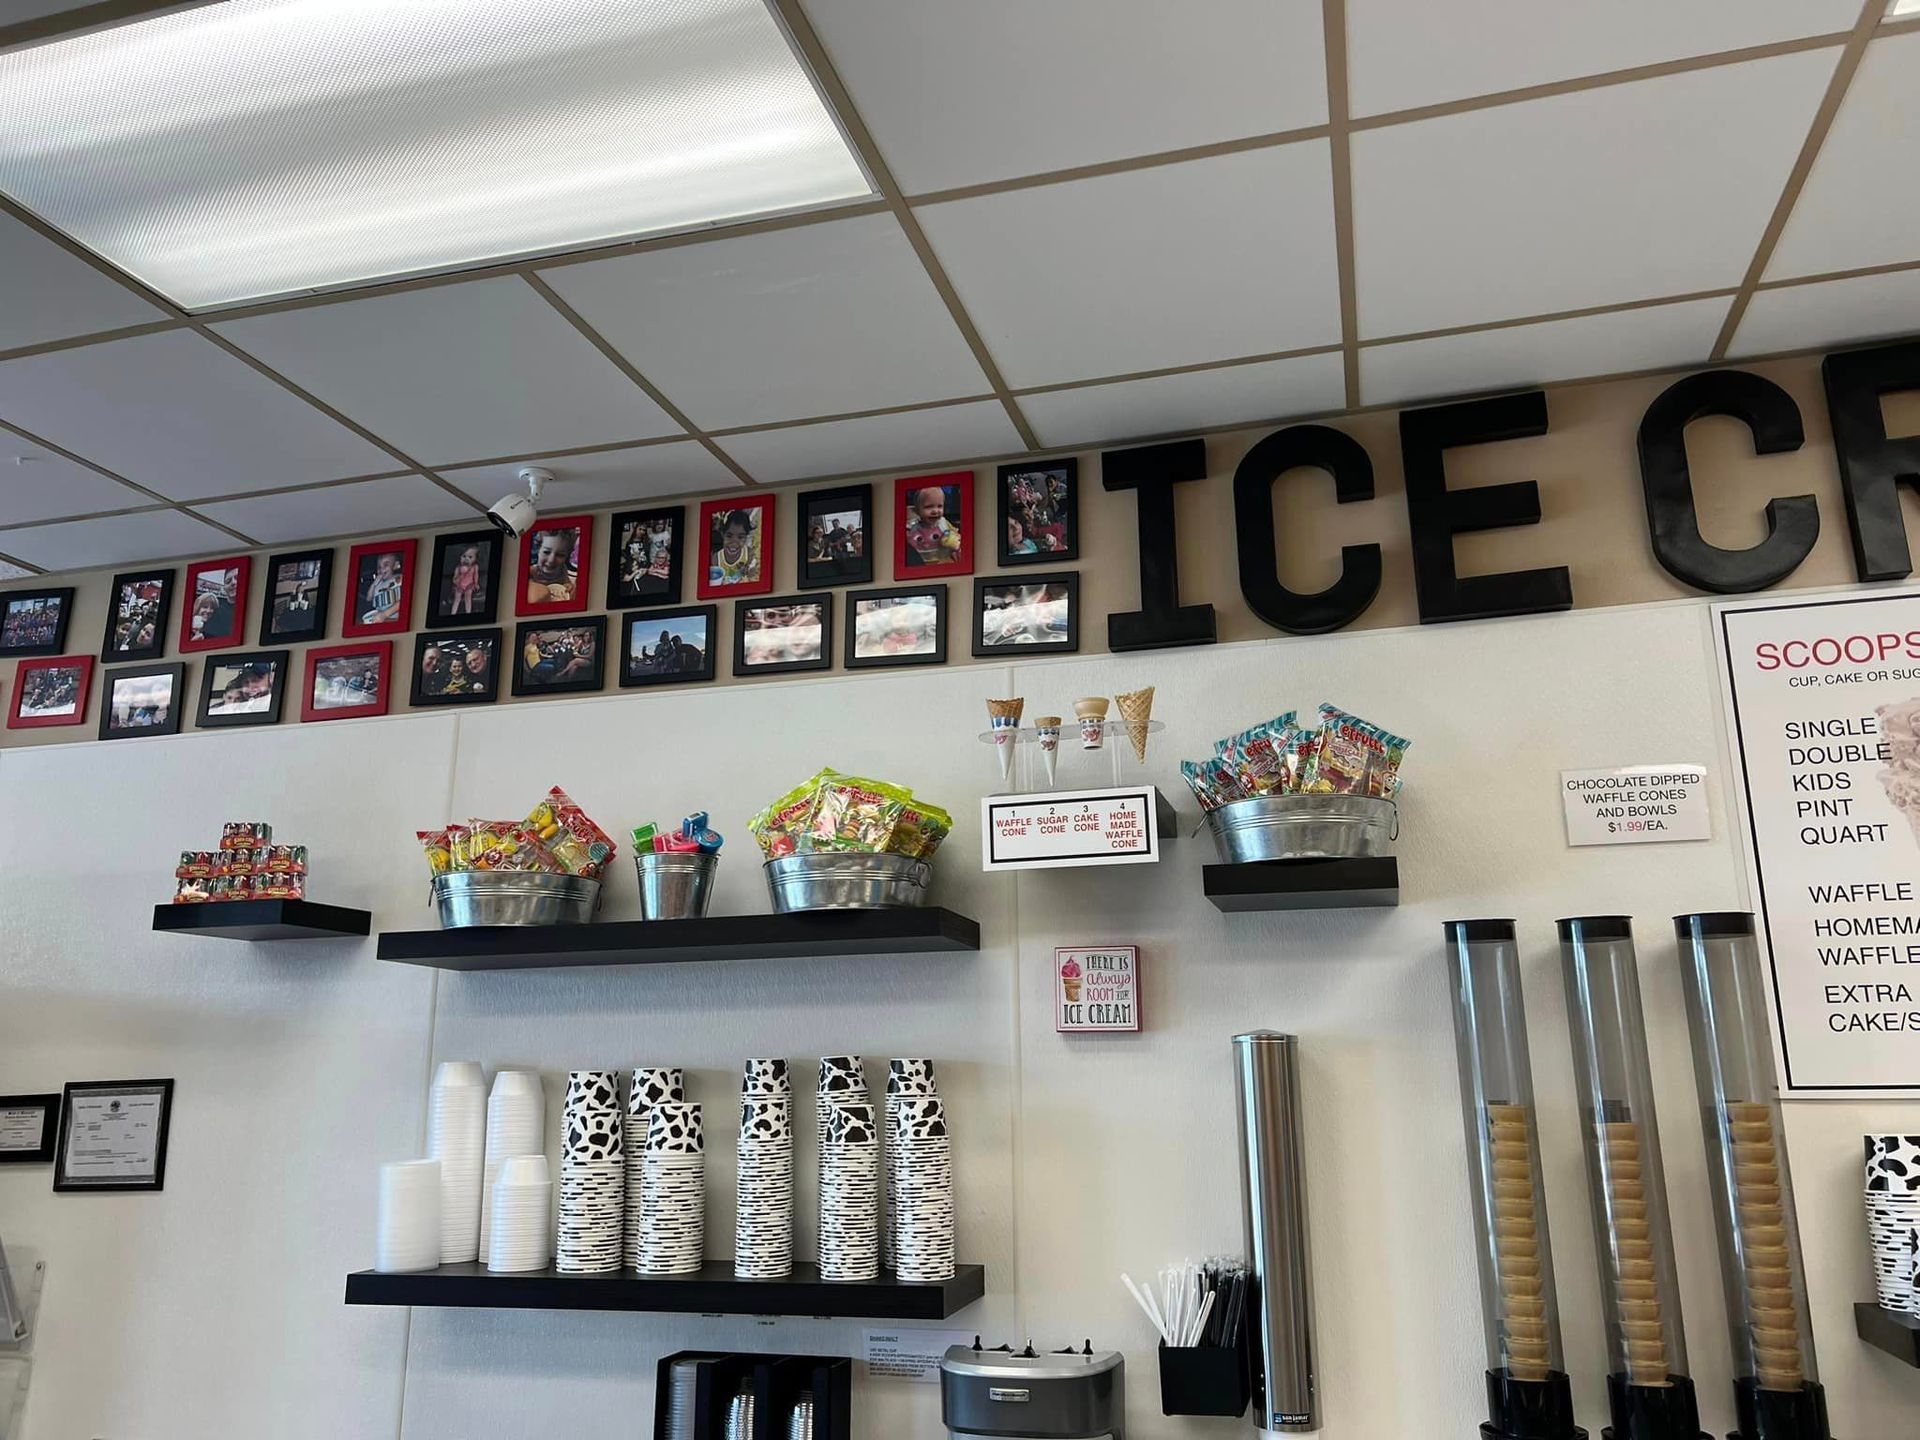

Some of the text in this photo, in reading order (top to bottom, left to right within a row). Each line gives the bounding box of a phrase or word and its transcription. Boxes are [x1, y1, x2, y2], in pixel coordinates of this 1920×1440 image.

[1101, 391, 1572, 652] ICE
[1789, 676, 1821, 688] CUP,
[1824, 672, 1863, 685] CAKE
[1867, 670, 1889, 682] OR
[1785, 717, 1877, 740] SINGLE
[1789, 743, 1893, 766] DOUBLE
[1566, 773, 1700, 791] CHOCOLATE DIPPED
[1792, 772, 1851, 792] KIDS
[1583, 789, 1687, 804] WAFFLE CONES
[1049, 807, 1055, 815] 2
[1083, 805, 1089, 813] 3
[1120, 802, 1125, 810] 4
[1596, 804, 1677, 818] AND BOWLS
[1796, 799, 1853, 818] PINT
[996, 817, 1032, 828] WAFFLE
[1036, 815, 1069, 825] SUGAR
[1073, 813, 1099, 823] CAKE
[1109, 811, 1137, 820] HOME
[1040, 825, 1066, 834] CONE
[1074, 823, 1100, 832] CONE
[1110, 820, 1137, 829] MADE
[1608, 820, 1668, 833] $1.99/EA.
[1001, 827, 1027, 837] CONE
[1105, 829, 1143, 839] WAFFLE
[1800, 824, 1888, 845] QUART
[1111, 839, 1138, 848] CONE
[1808, 883, 1913, 903] WAFFLE
[1086, 956, 1128, 970] THERE IS
[1818, 946, 1920, 966] WAFFLE
[1086, 972, 1131, 989] always
[1086, 987, 1114, 1001] ROOM
[1824, 983, 1913, 1004] EXTRA
[1063, 1003, 1131, 1024] ICE CREAM
